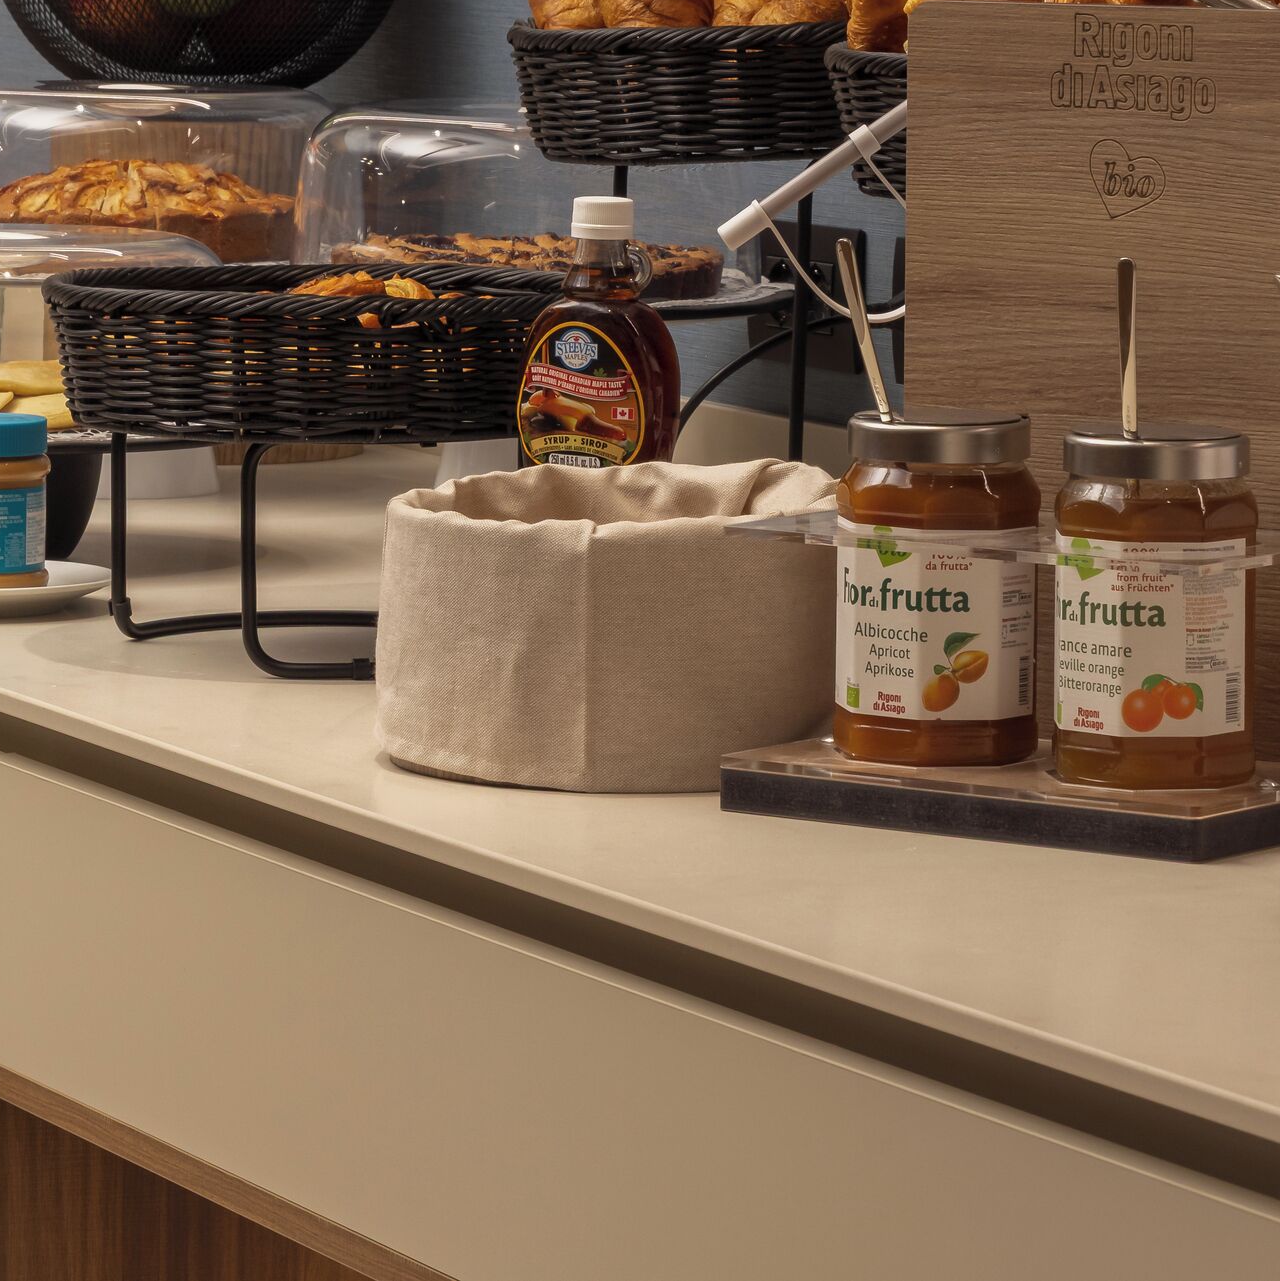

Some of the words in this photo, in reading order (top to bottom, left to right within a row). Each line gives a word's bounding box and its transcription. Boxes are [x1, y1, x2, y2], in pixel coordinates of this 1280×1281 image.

[1074, 13, 1194, 67] Rigoni
[1102, 161, 1156, 198] bio
[556, 342, 596, 357] STEEVES
[531, 366, 549, 375] NATURAL
[549, 369, 568, 380] ORIGINAL
[569, 375, 591, 387] CANADIAN
[591, 379, 608, 389] MAPLE
[543, 435, 570, 446] SYRUP
[580, 437, 608, 450] SIROP
[550, 454, 559, 464] 250
[925, 561, 937, 571] da
[1116, 573, 1139, 582] from
[843, 566, 873, 606] Fior
[868, 596, 879, 607] di
[880, 577, 970, 613] frutta
[1110, 584, 1125, 592] aus
[1069, 610, 1078, 622] di
[1079, 591, 1166, 627] frutta
[854, 622, 928, 642] Albicocche
[869, 643, 911, 660] Apricot
[1059, 639, 1088, 654] ance
[1091, 643, 1132, 658] amare
[864, 661, 914, 678] Aprikose
[1059, 658, 1086, 672] eville
[1088, 663, 1125, 679] orange
[877, 691, 902, 704] Rigoni
[1077, 707, 1100, 719] Rigoni
